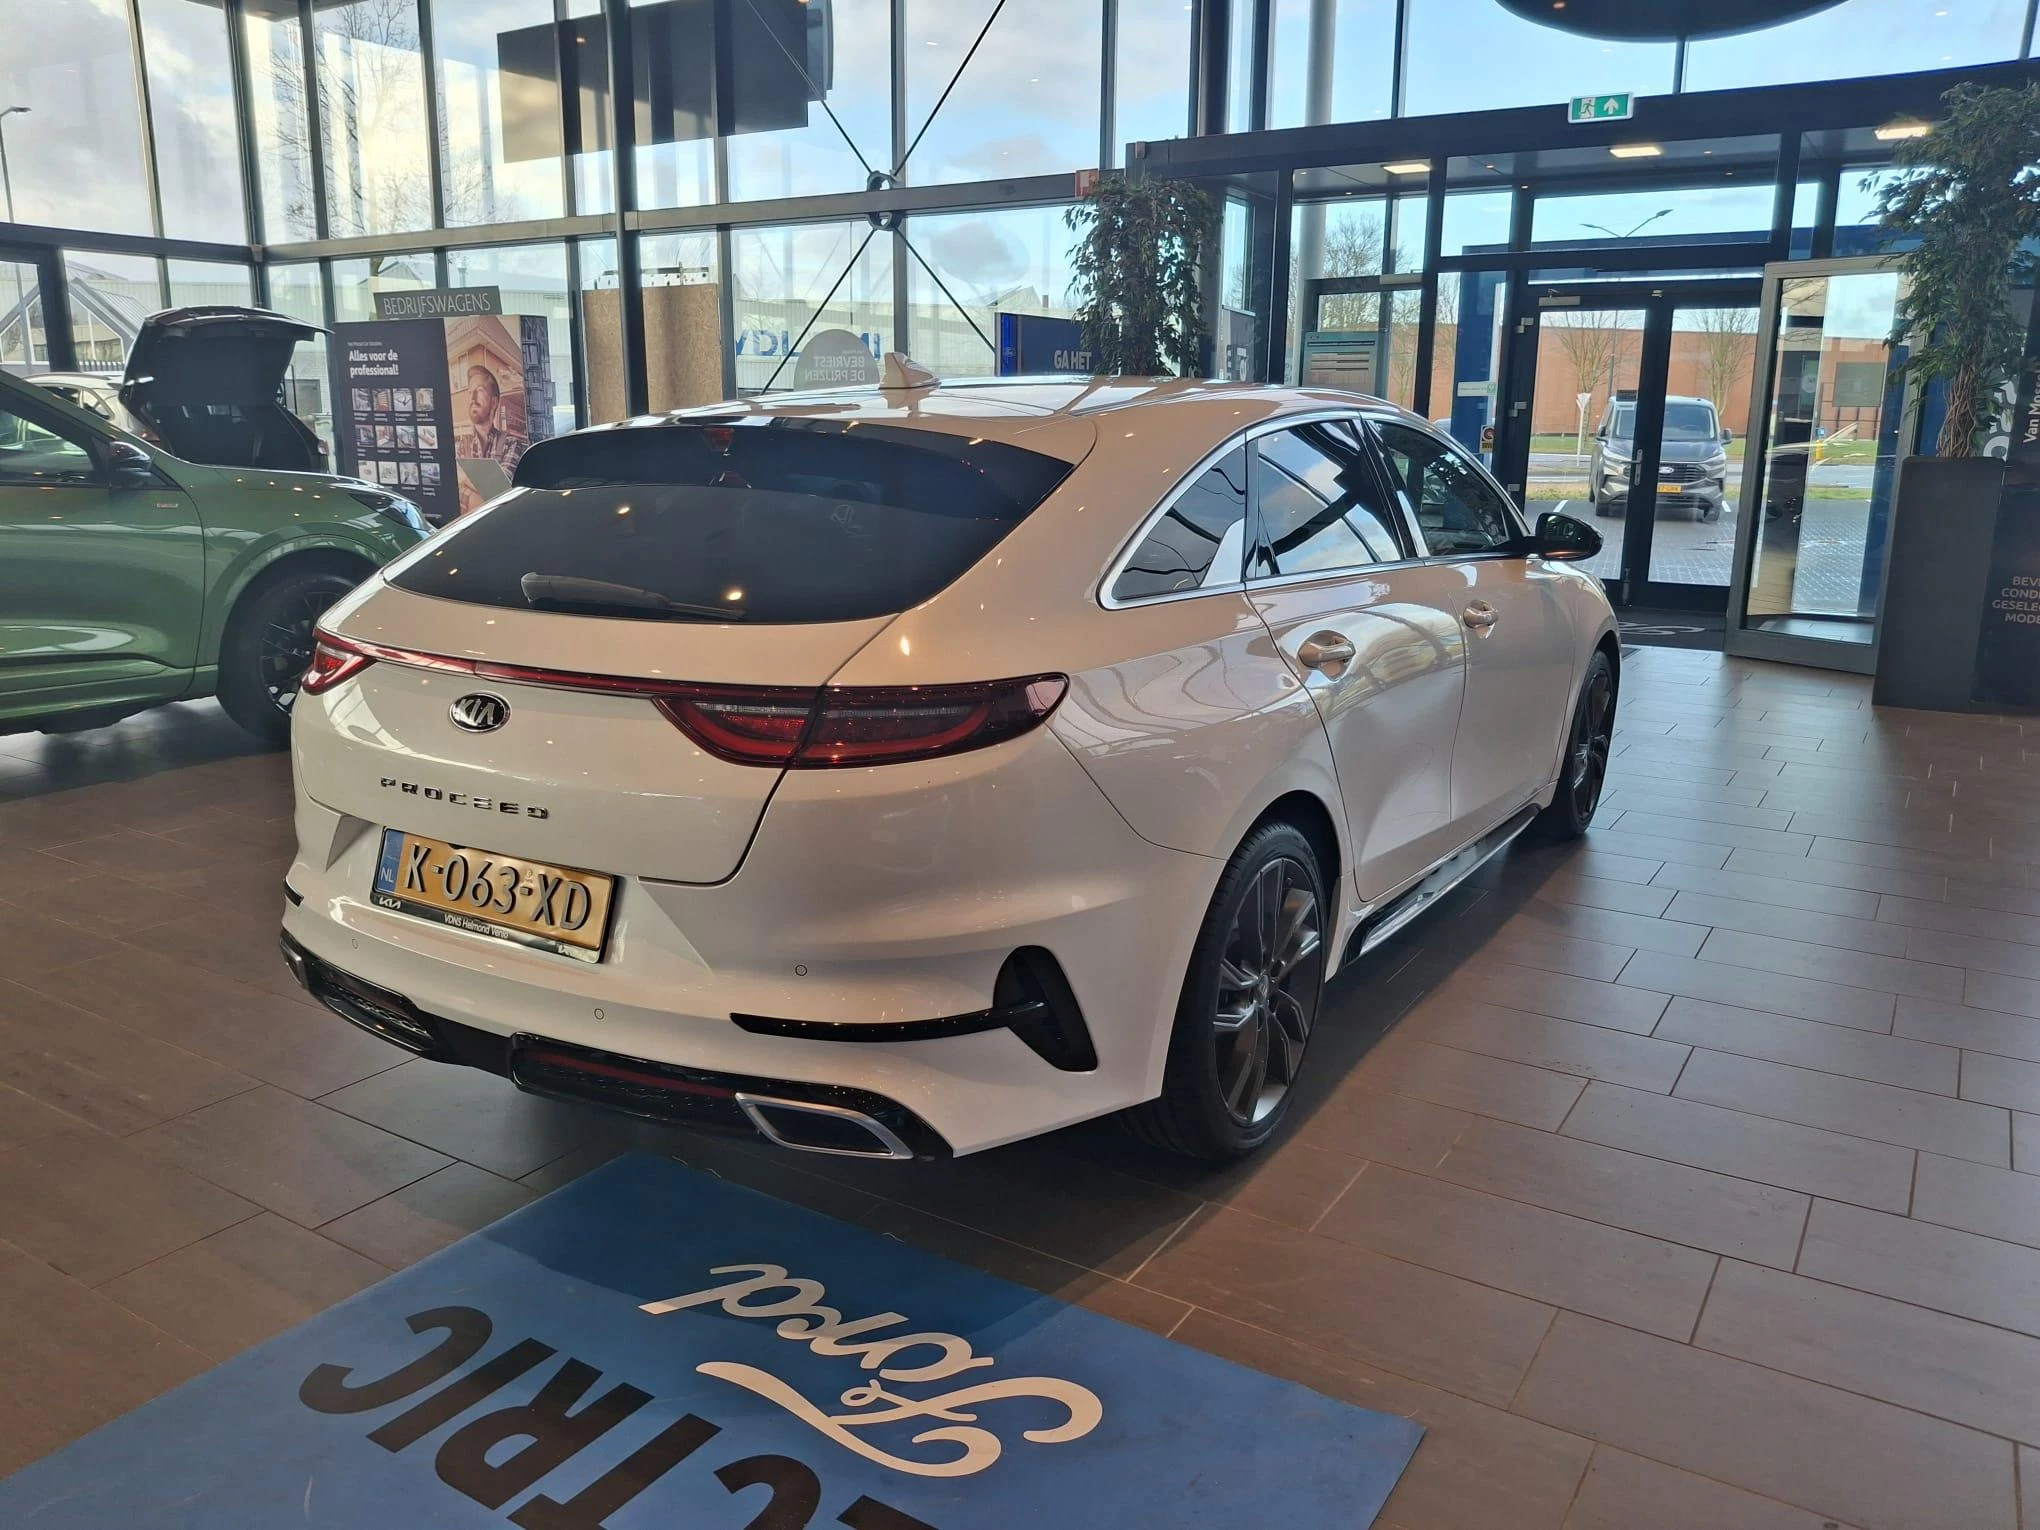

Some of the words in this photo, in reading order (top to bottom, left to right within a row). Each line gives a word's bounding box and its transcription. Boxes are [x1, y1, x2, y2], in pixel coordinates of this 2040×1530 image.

[383, 293, 491, 317] BEDRIJFSWAGENS
[349, 350, 368, 361] Alles
[369, 352, 386, 361] voor
[387, 349, 398, 361] de
[1053, 350, 1069, 369] GA
[1070, 351, 1092, 370] HET
[350, 364, 399, 378] professional!
[2023, 418, 2039, 443] Van
[2012, 576, 2040, 587] BEV
[1992, 600, 2040, 612] GESELE
[454, 698, 497, 727] KIA
[380, 777, 549, 819] PROCEED
[381, 867, 394, 883] NL
[404, 843, 592, 930] K-063-XD
[379, 896, 401, 909] KIA
[462, 917, 490, 934] Helmond
[638, 1263, 1103, 1477] Ford
[299, 1305, 938, 1530] CTRIC
